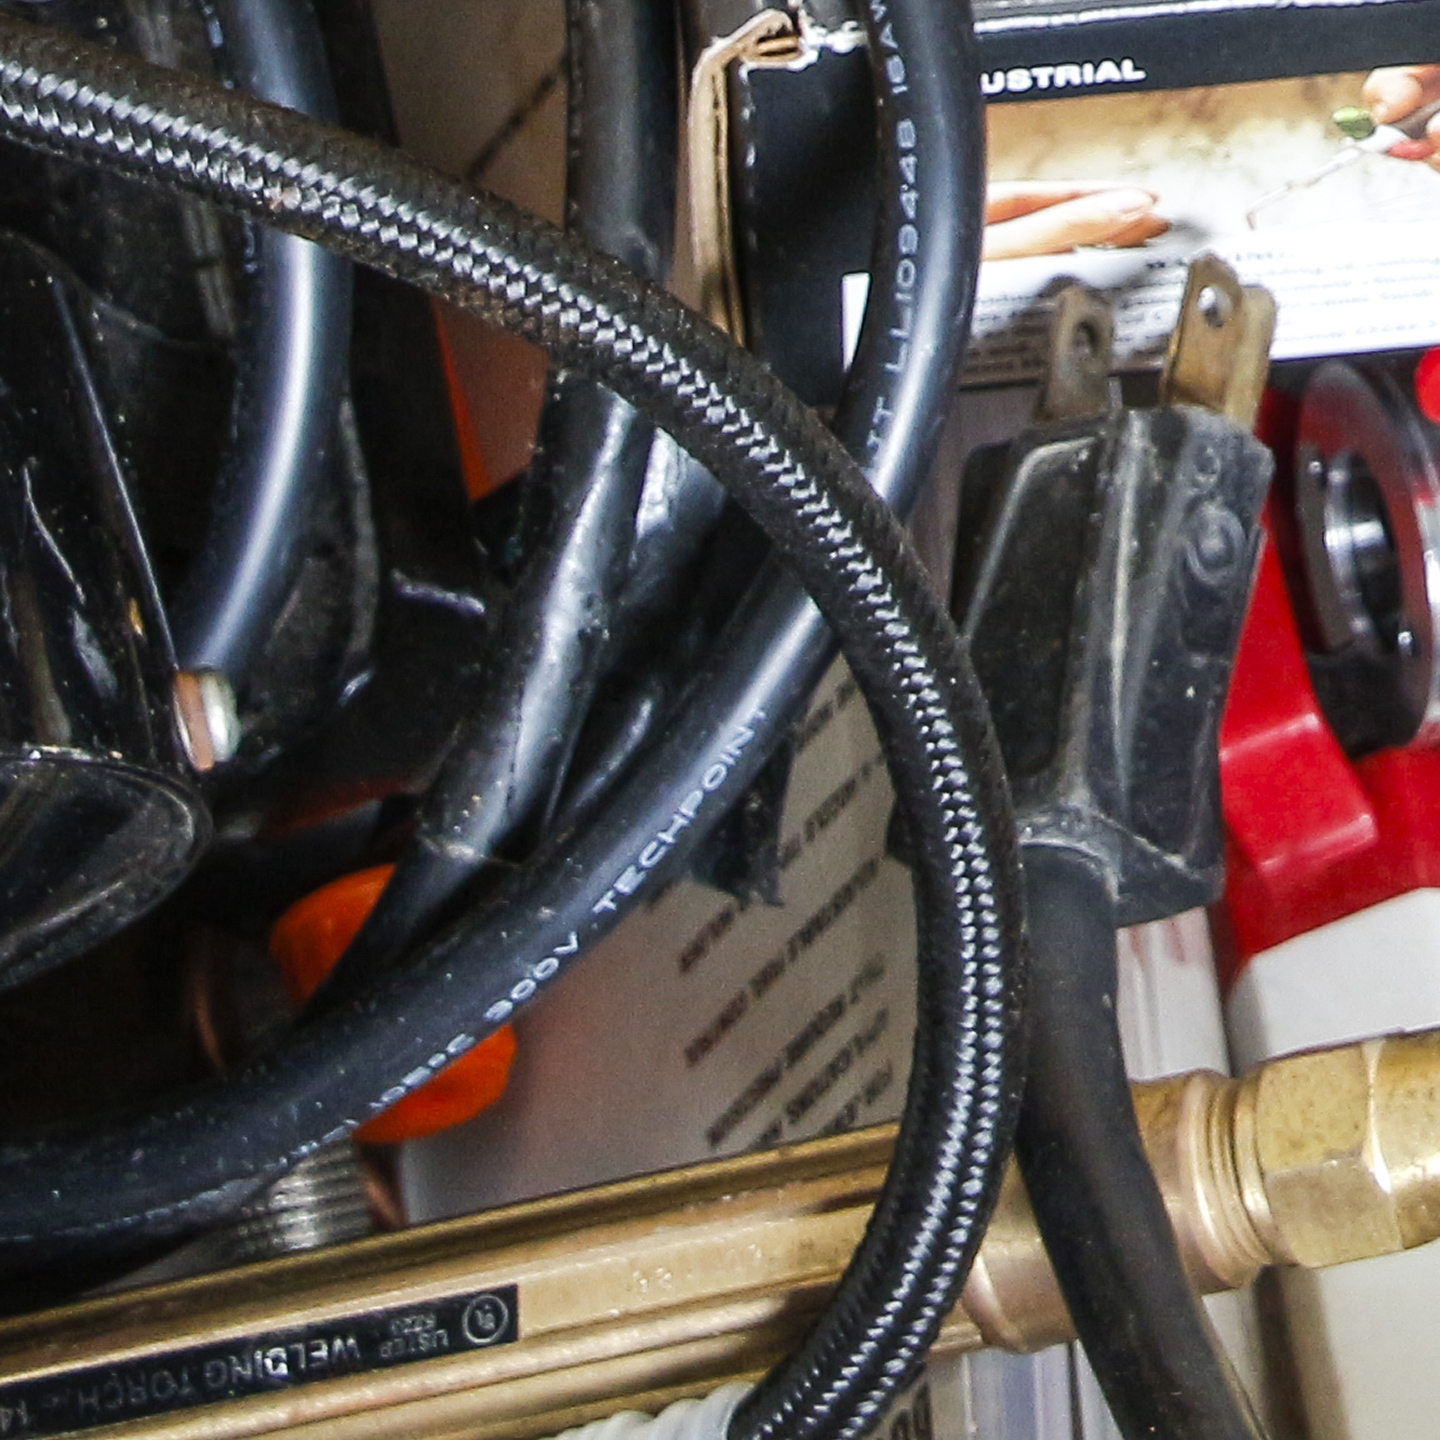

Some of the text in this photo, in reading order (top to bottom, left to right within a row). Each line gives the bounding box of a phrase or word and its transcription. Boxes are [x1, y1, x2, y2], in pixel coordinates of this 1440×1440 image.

[980, 58, 1147, 94] USTRIAL
[594, 710, 766, 917] TECHPOINT
[203, 1333, 361, 1388] WELDING
[75, 1365, 192, 1413] TORCH
